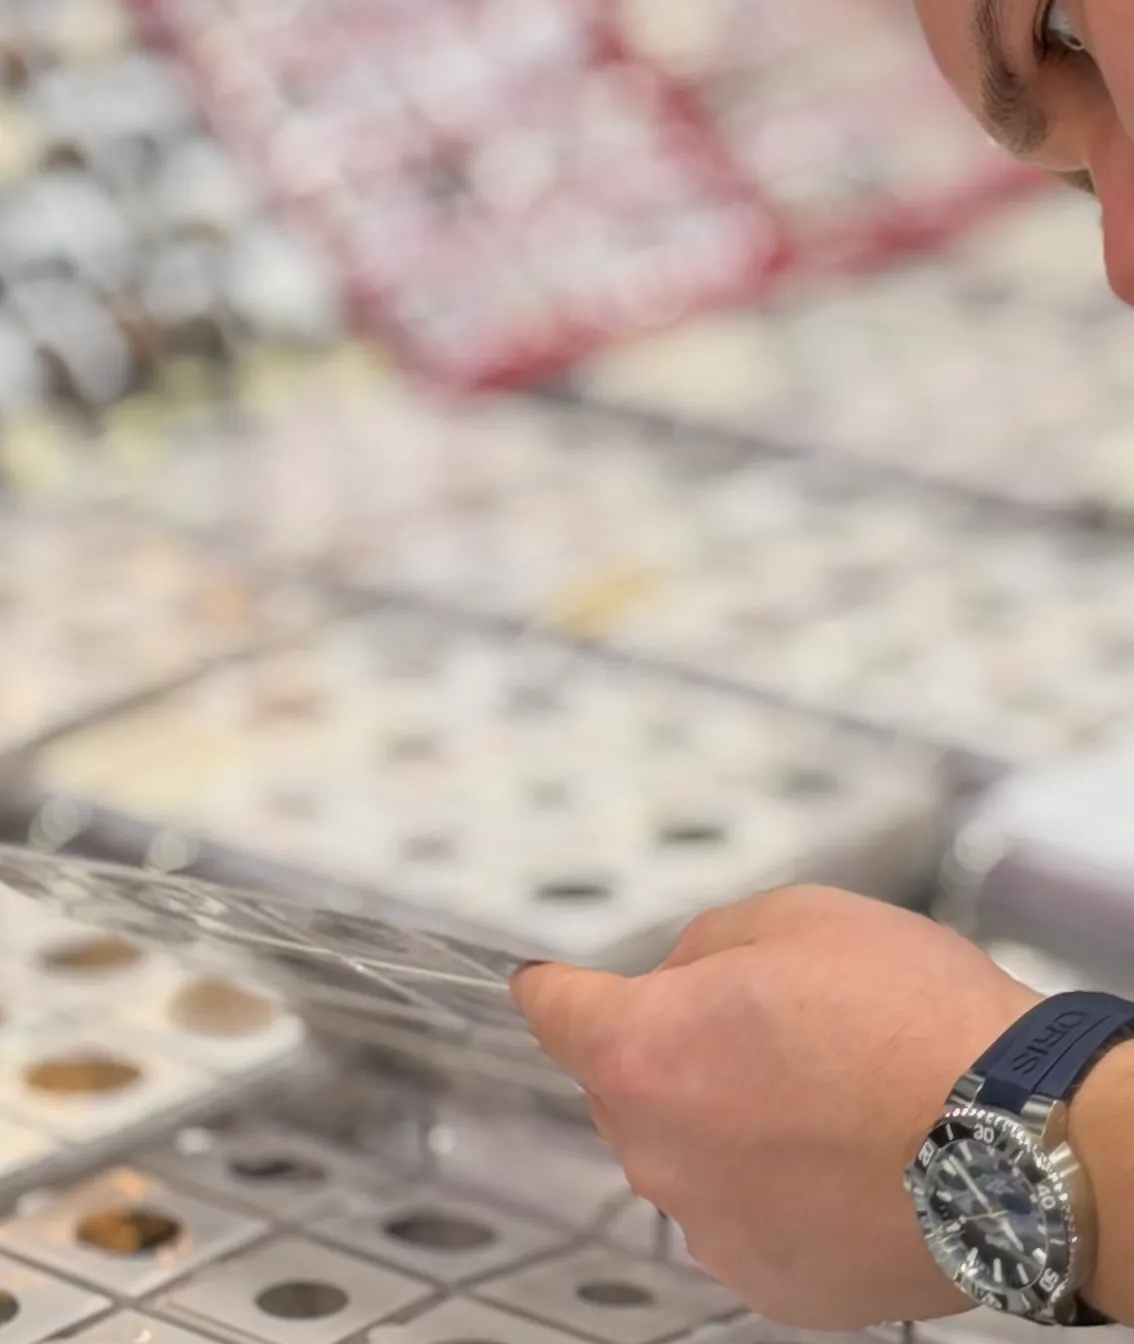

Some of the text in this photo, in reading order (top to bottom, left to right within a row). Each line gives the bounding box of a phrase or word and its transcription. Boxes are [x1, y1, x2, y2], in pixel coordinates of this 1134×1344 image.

[1011, 1010, 1090, 1075] ORIS
[972, 1123, 995, 1144] 30
[1036, 1184, 1056, 1210] 40
